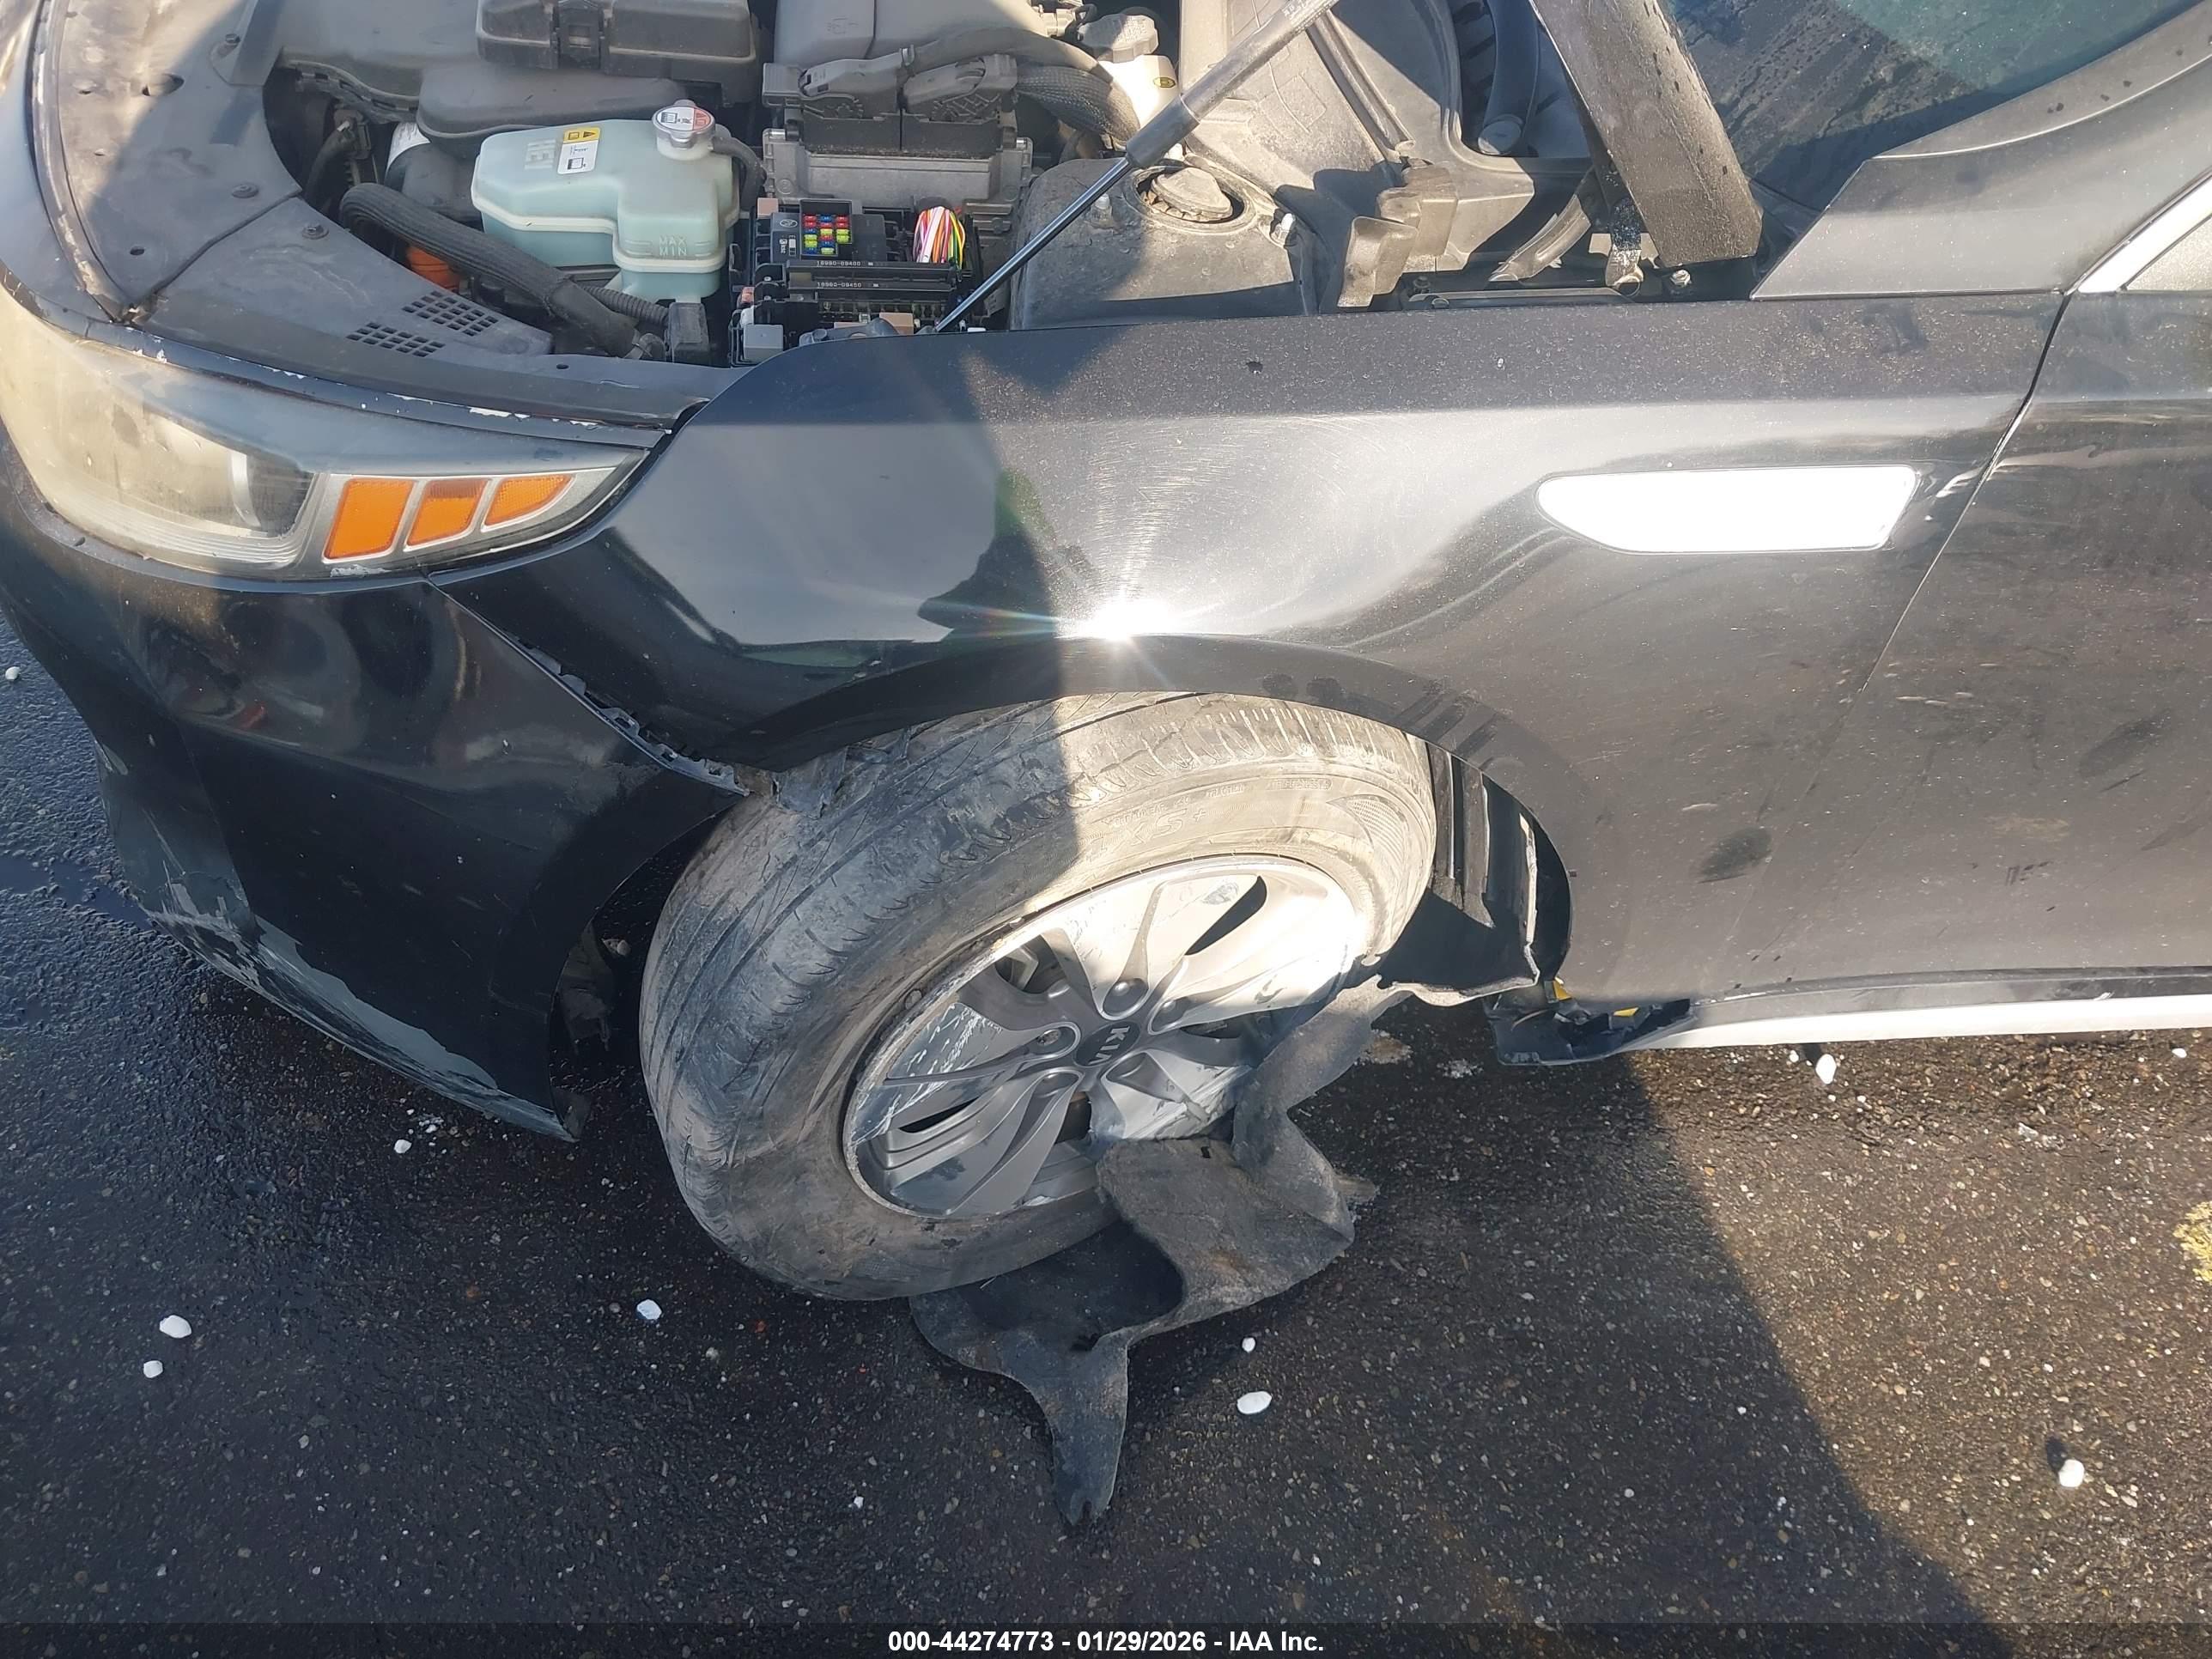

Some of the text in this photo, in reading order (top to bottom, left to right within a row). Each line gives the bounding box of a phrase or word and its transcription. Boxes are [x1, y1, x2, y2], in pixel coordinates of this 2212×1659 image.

[659, 234, 687, 246] MAX
[659, 246, 687, 257] MIN
[1088, 1026, 1130, 1065] KIA
